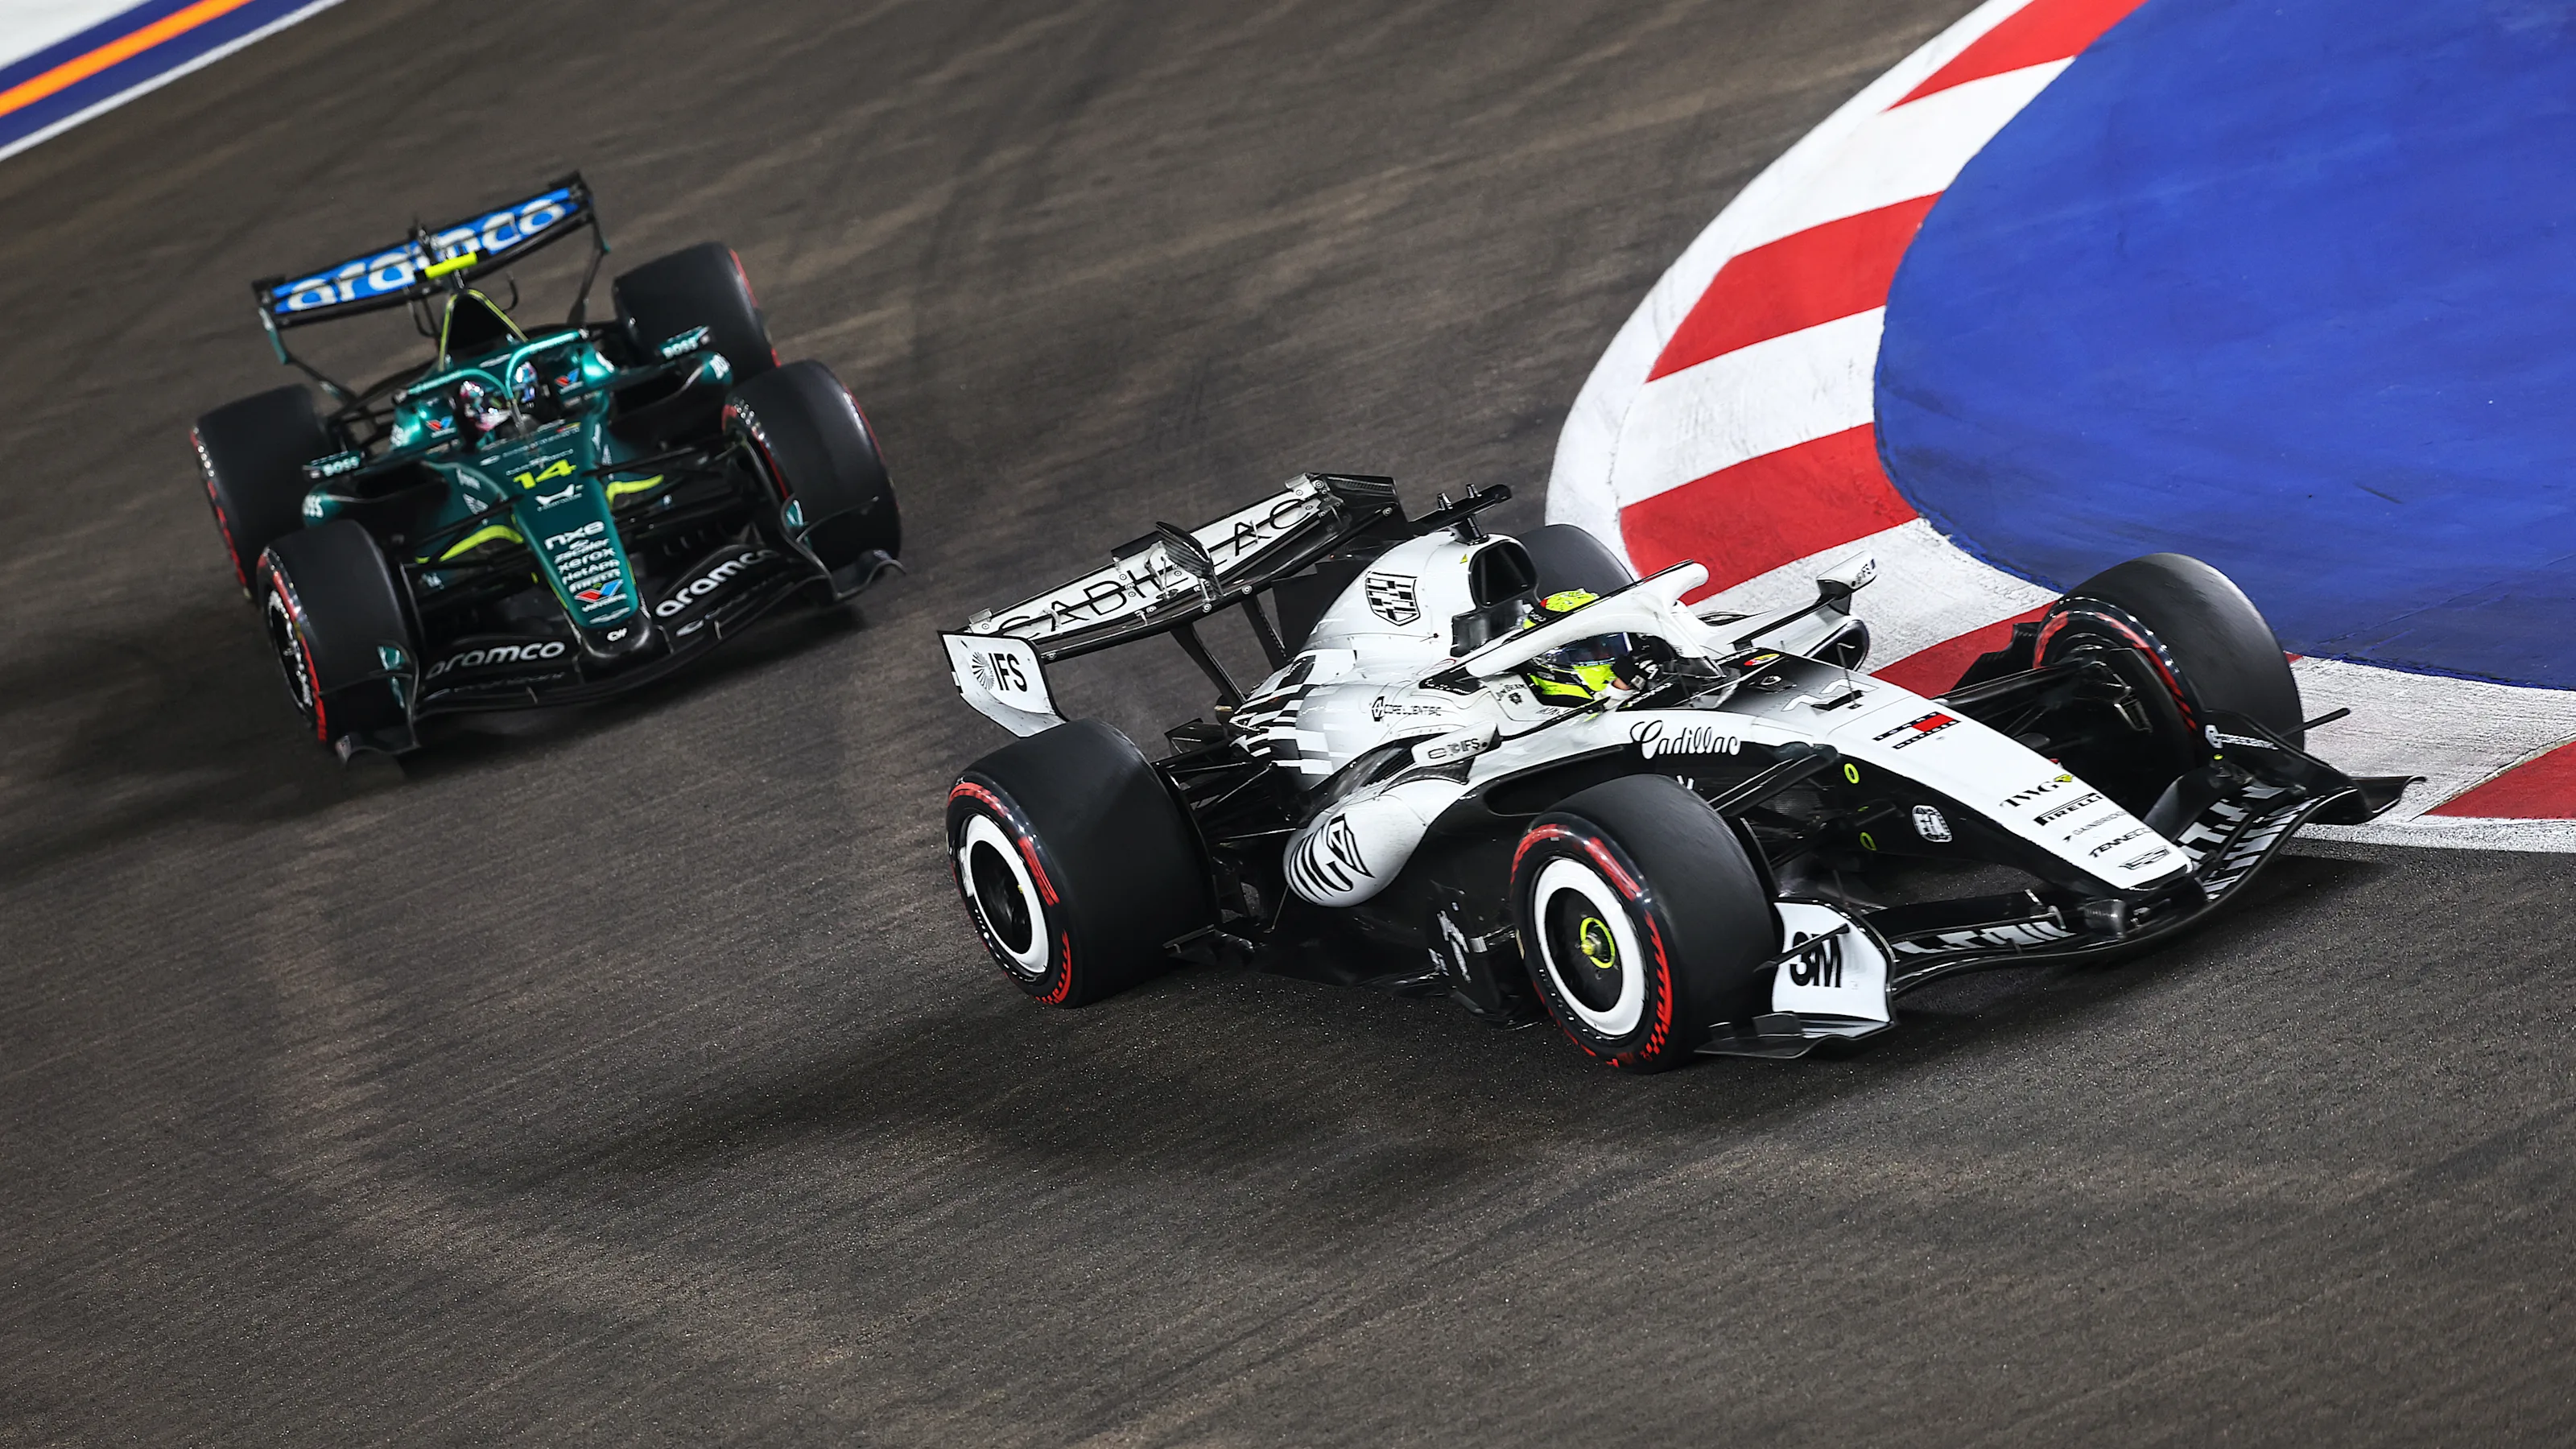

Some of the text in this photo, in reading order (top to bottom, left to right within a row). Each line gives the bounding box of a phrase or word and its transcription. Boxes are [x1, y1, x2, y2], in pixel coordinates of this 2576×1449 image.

[287, 198, 565, 307] aramco
[323, 456, 361, 477] BOSS
[513, 458, 578, 490] 14
[655, 548, 780, 618] aramco
[997, 497, 1313, 640] CADILAC
[425, 641, 566, 680] aramco
[988, 652, 1028, 692] IFS
[1629, 719, 1742, 760] Cadillac
[1999, 781, 2059, 807] TWG
[2033, 792, 2103, 827] PIRELLI
[1790, 931, 1843, 989] 3M
